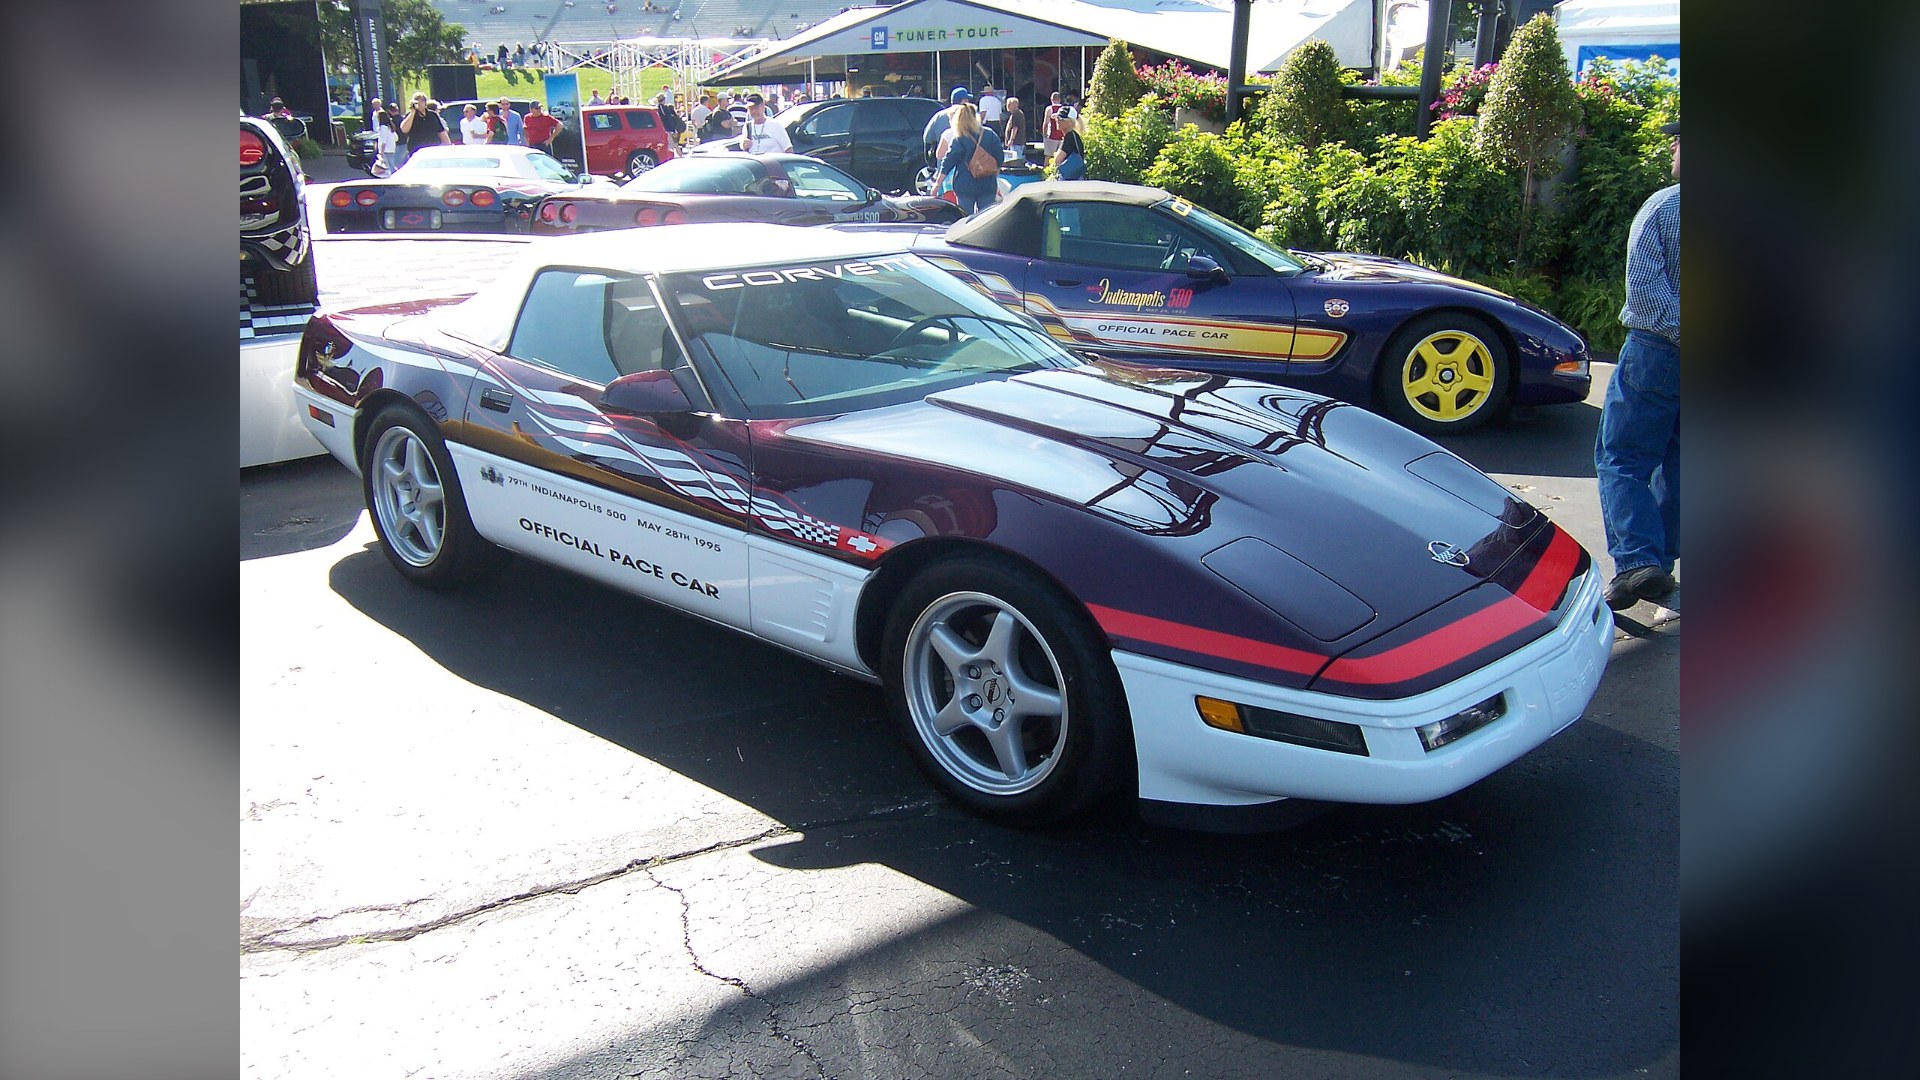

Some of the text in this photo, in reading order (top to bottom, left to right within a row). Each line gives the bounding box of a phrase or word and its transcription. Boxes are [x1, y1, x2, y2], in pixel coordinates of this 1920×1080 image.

[370, 33, 378, 50] NEW
[874, 31, 885, 42] GM
[896, 27, 999, 42] TUNER TOUR
[372, 50, 381, 74] CHEVY
[864, 212, 880, 223] 500
[702, 257, 928, 291] CORVETTE
[1088, 278, 1193, 311] Indianapolis 500
[1097, 324, 1229, 340] OFFICIAL PACE CAR
[531, 483, 603, 514] INDIANAPOLIS
[606, 508, 627, 521] 500
[637, 518, 661, 533] MAY
[694, 536, 722, 553] 1995
[519, 517, 720, 600] OFFICIAL PACE CAR
